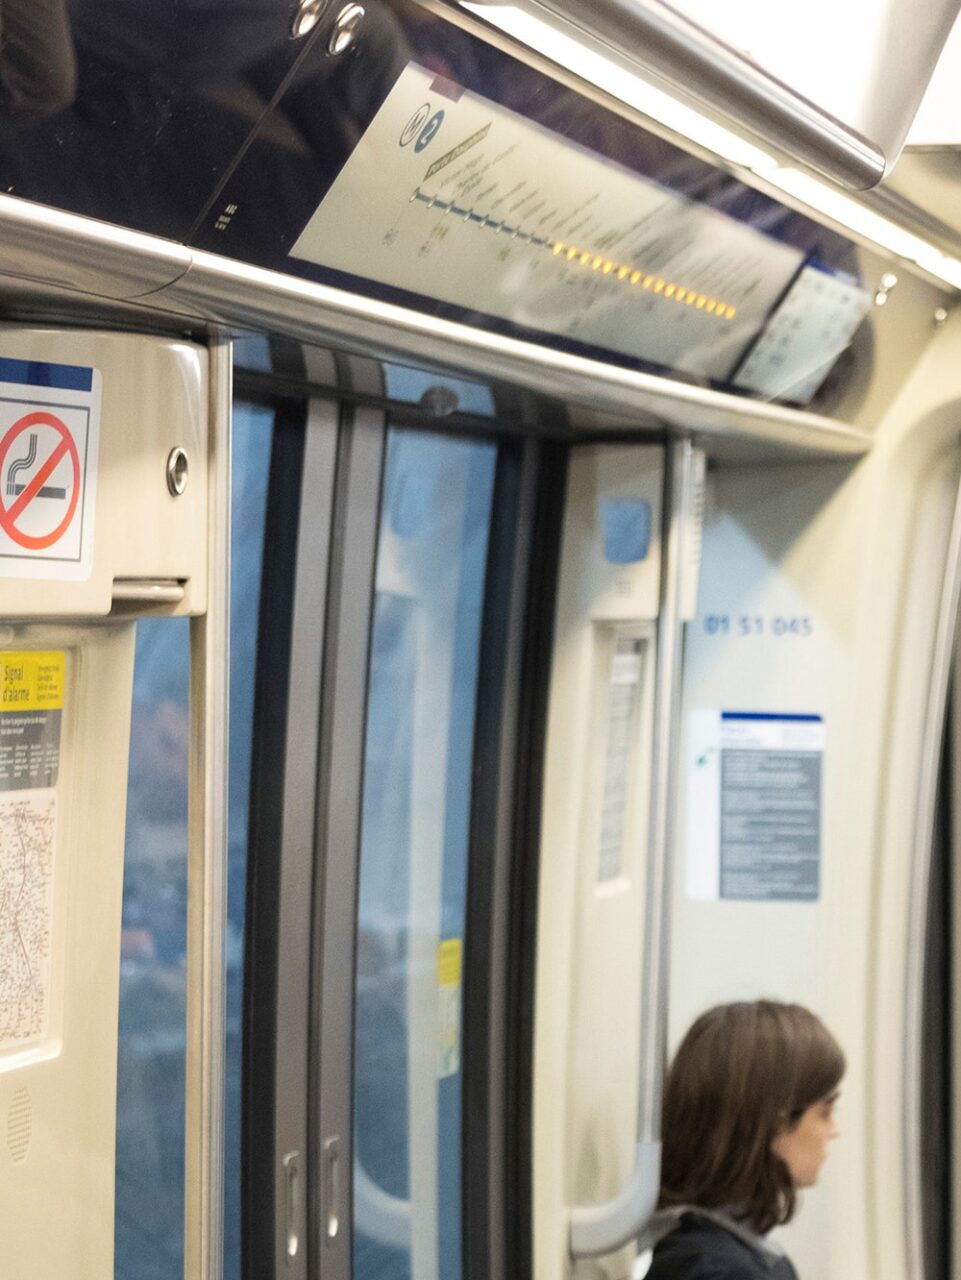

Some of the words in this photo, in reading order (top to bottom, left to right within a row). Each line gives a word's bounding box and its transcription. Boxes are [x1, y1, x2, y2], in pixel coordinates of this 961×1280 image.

[420, 118, 439, 145] 2
[704, 614, 729, 636] 01
[739, 614, 763, 636] 51
[4, 664, 24, 686] Signal
[3, 687, 30, 702] d'alarme
